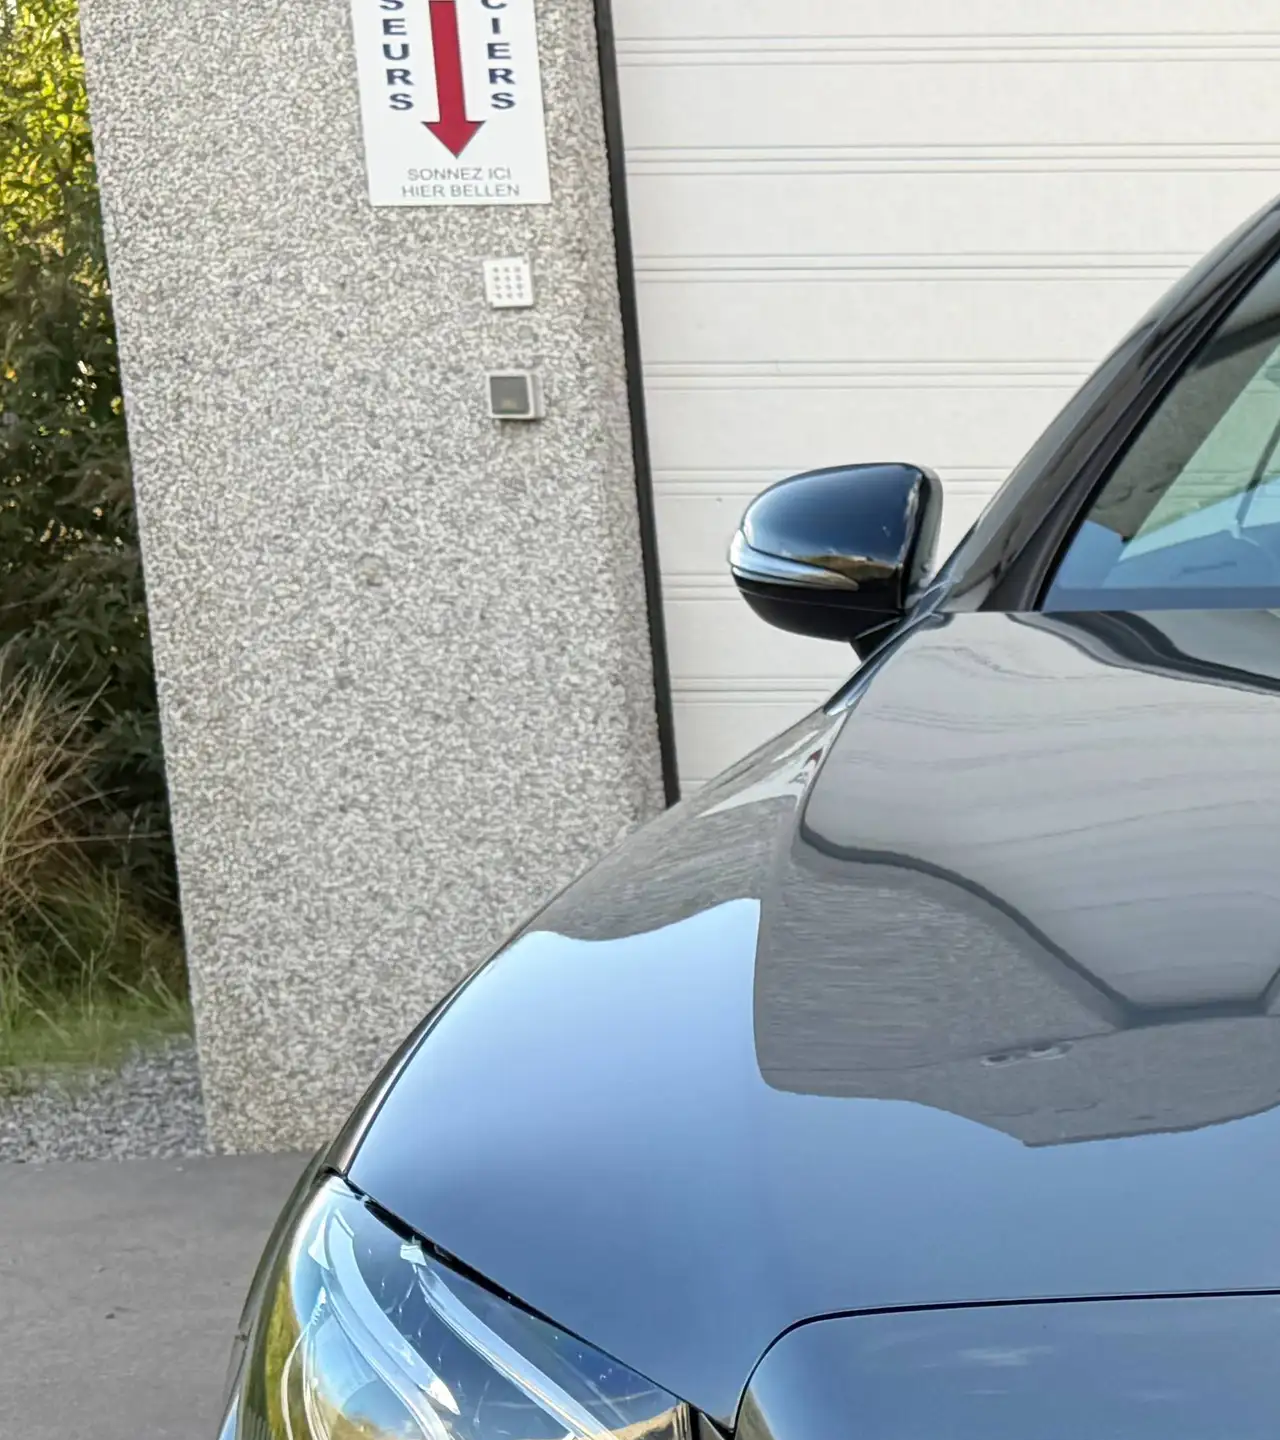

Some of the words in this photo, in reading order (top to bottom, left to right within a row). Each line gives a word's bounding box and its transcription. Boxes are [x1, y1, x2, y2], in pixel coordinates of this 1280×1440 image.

[407, 168, 483, 181] SONNEZ
[488, 167, 511, 180] ICI
[401, 184, 446, 197] HIER
[450, 184, 519, 197] BELLEN
